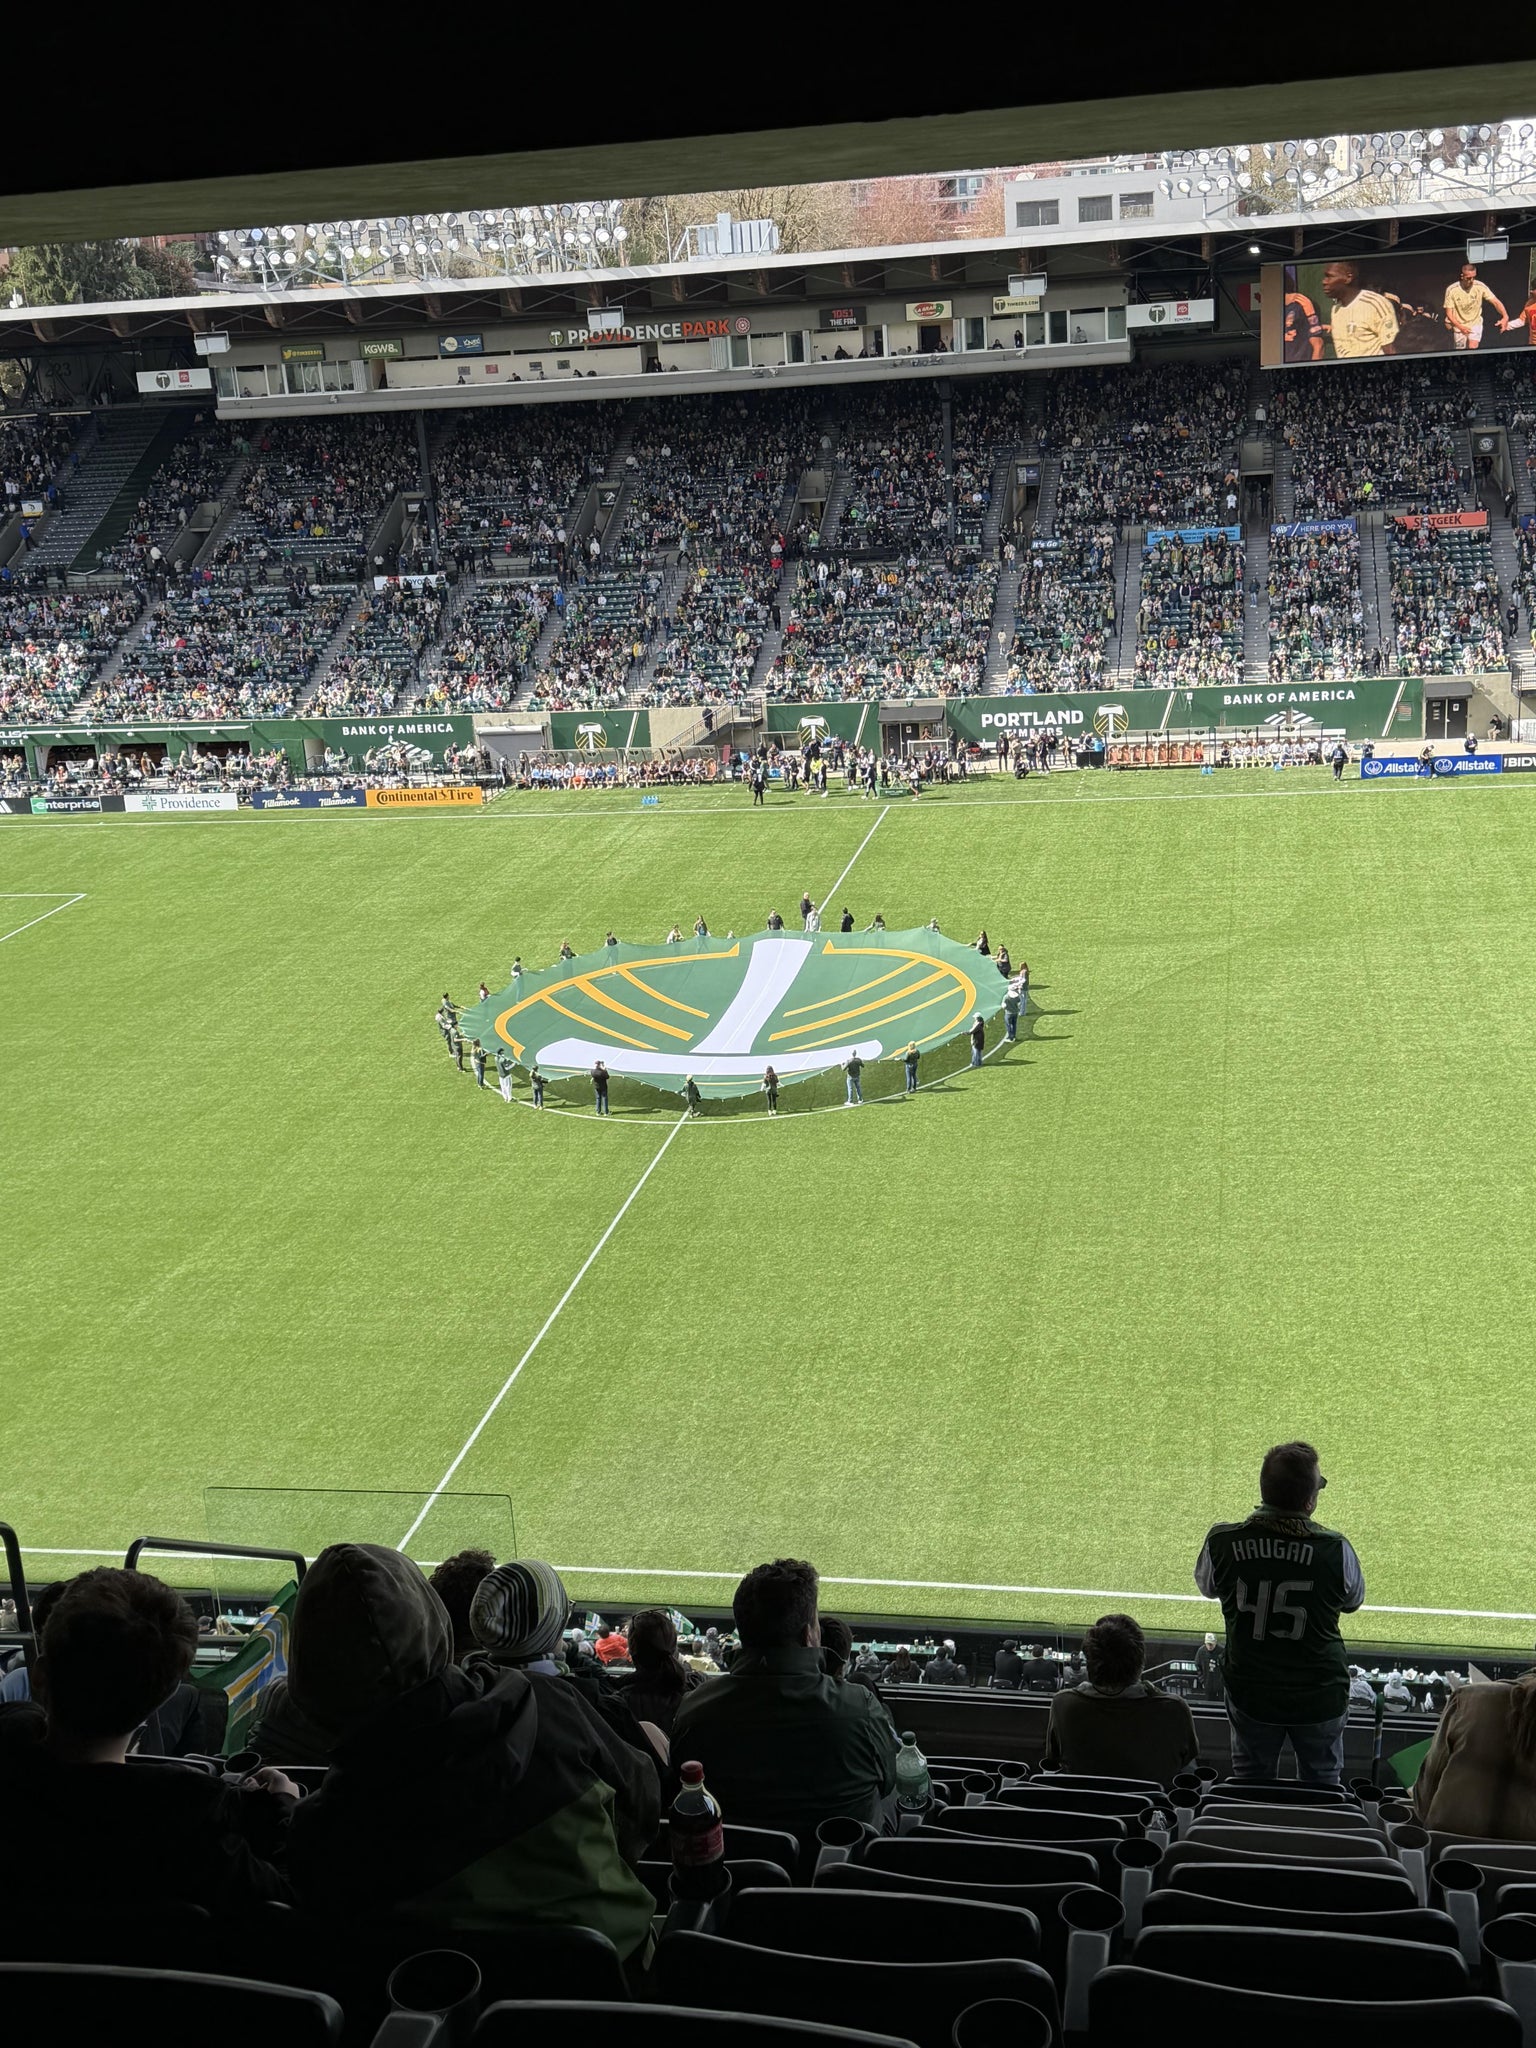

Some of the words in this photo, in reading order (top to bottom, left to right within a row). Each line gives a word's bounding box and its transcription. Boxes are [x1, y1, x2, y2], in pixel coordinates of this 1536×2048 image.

[830, 318, 842, 326] THE
[843, 317, 856, 325] FAN
[1414, 515, 1462, 527] STGEEK
[1301, 525, 1319, 533] HERE
[1223, 694, 1263, 705] BANK
[1266, 693, 1285, 703] OF
[1288, 690, 1355, 702] AMERICA
[981, 710, 1084, 728] PORTLAND
[342, 726, 376, 735] BANK
[379, 725, 394, 734] OF
[398, 723, 453, 734] AMERICA
[1453, 760, 1496, 772] Allstate
[160, 797, 221, 809] Providence
[262, 797, 301, 808] Tillamook
[319, 796, 357, 807] Tillamook
[376, 790, 437, 805] Continental
[447, 789, 474, 800] Tire
[34, 800, 99, 810] enterprise
[1231, 1537, 1314, 1566] HAUGAN
[1236, 1576, 1314, 1641] 45
